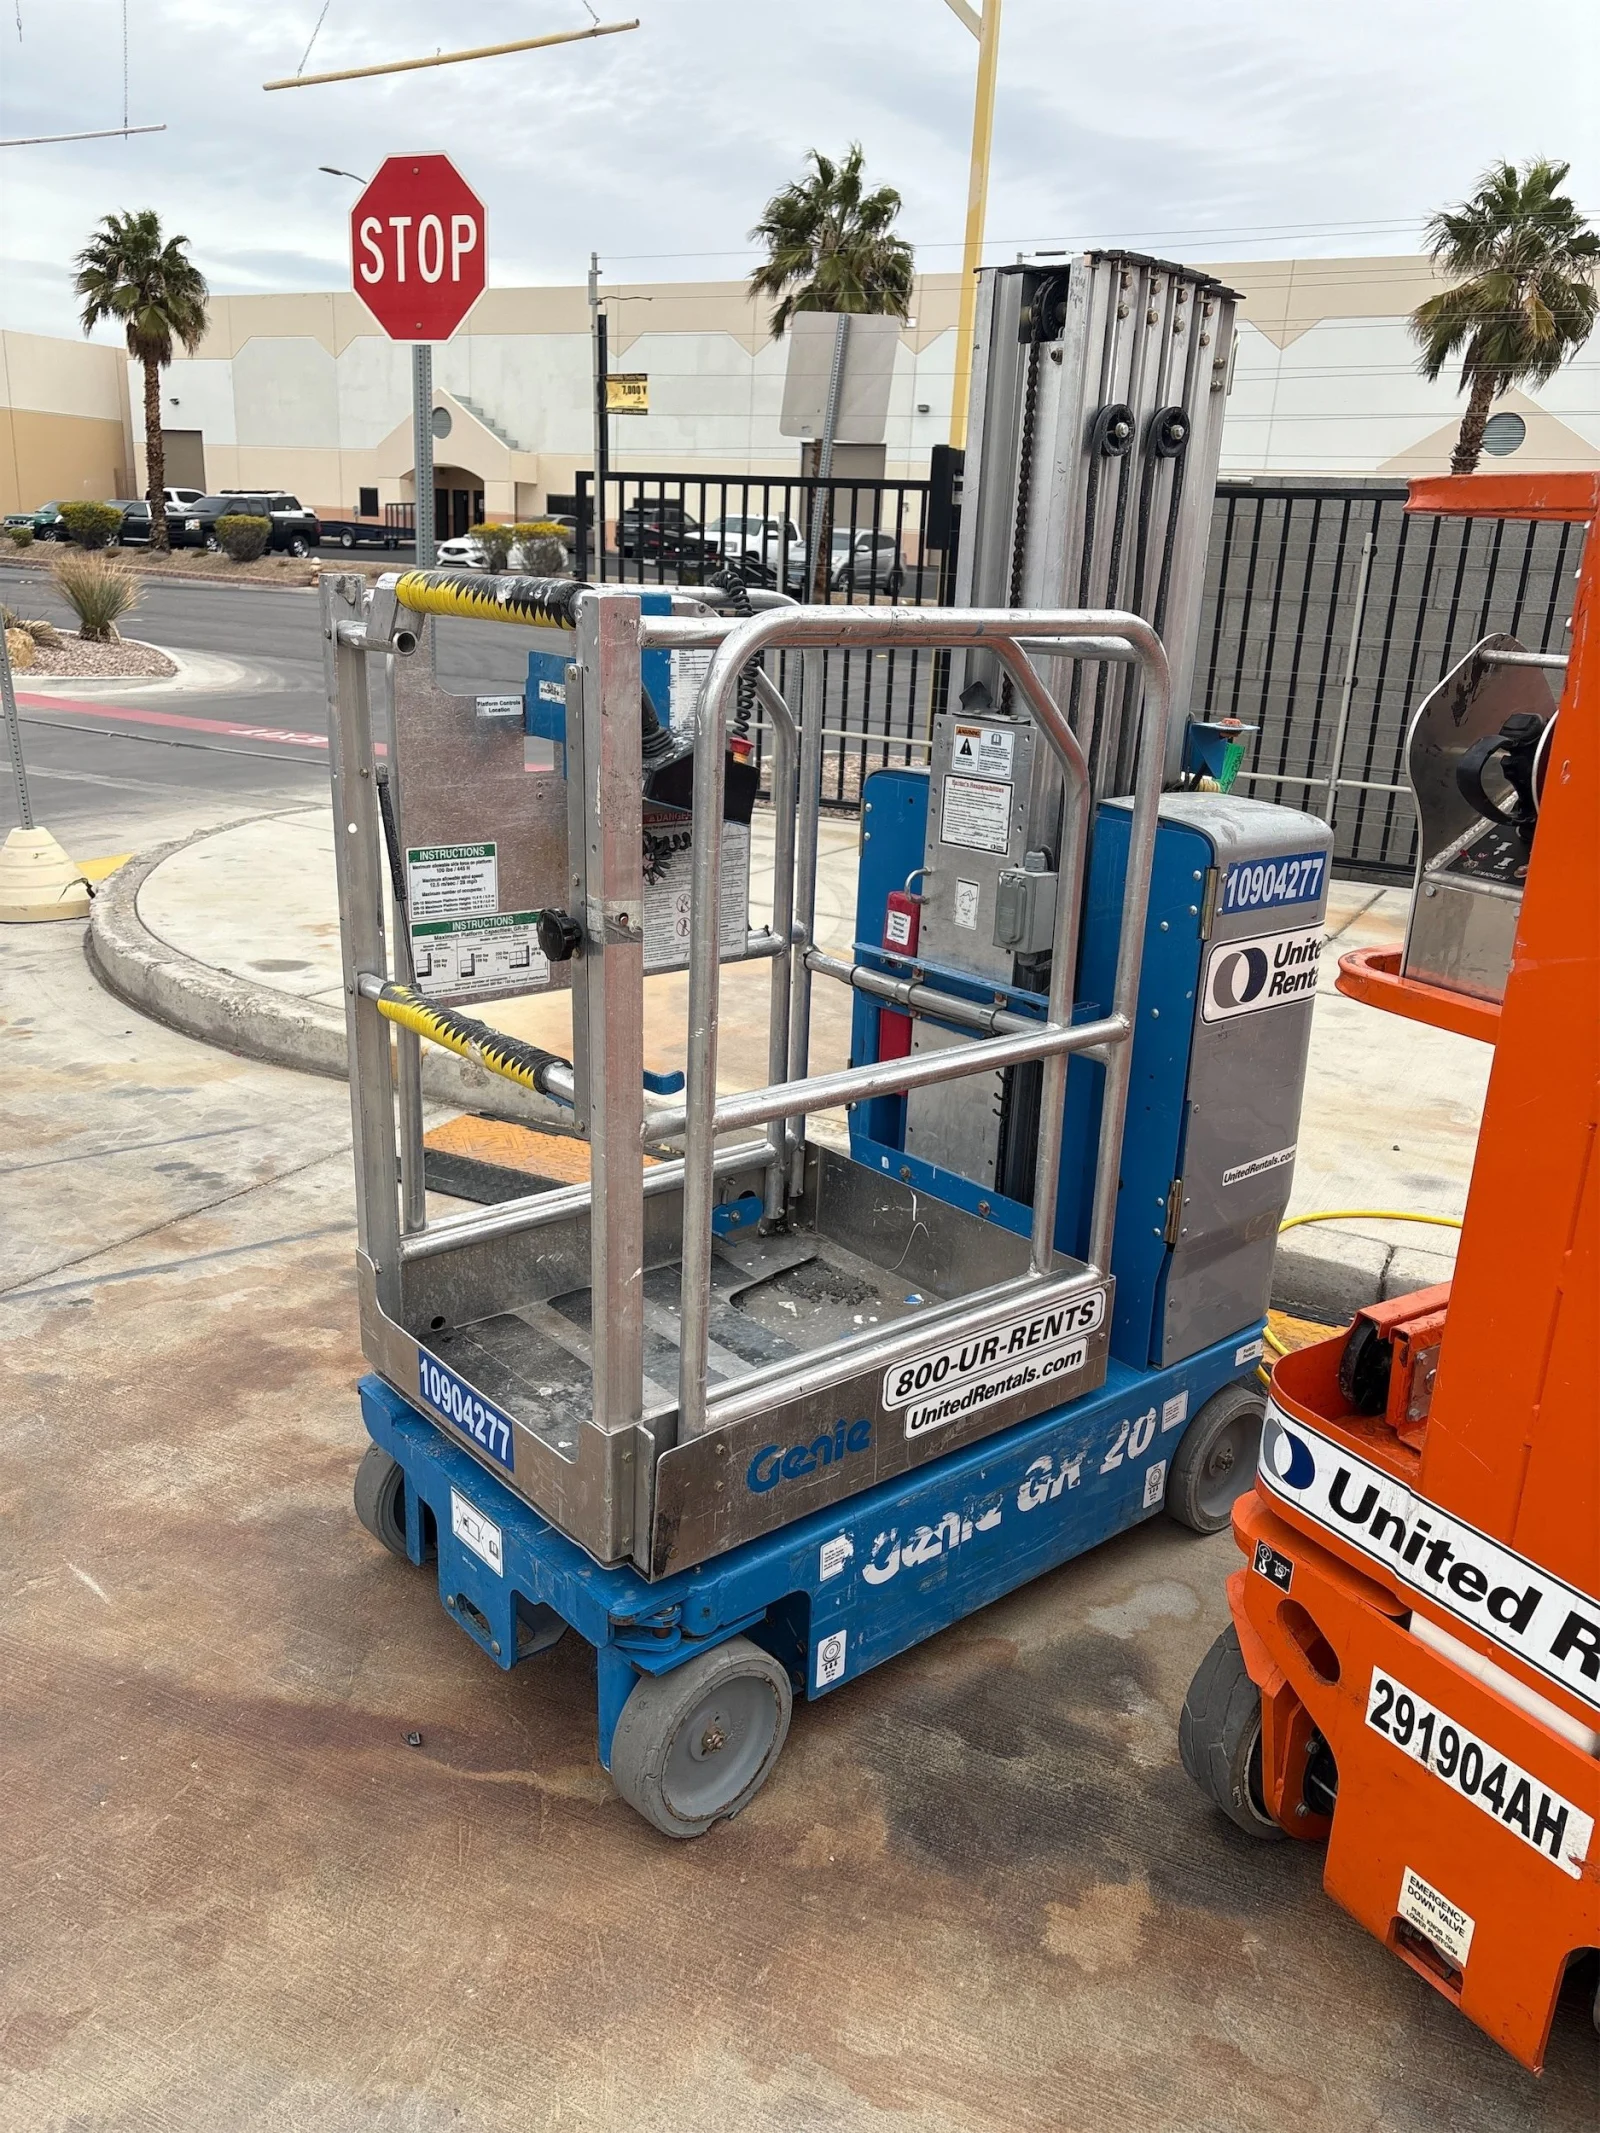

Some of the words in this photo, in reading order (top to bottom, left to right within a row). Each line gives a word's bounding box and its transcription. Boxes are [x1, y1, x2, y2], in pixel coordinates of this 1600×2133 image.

[360, 213, 478, 284] STOP
[621, 385, 641, 395] 7,000
[420, 846, 485, 860] INSTRUCTIONS
[1227, 858, 1324, 908] 10904277
[452, 916, 514, 931] INSTRUCTIONS
[895, 1300, 1095, 1397] 800-UR-RENTS
[420, 1358, 510, 1461] 10904277
[911, 1350, 1082, 1430] UnitedRentals.com
[746, 1417, 872, 1493] Genie
[1099, 1407, 1157, 1475] 20
[1328, 1466, 1543, 1635] United
[1369, 1678, 1569, 1860] 291904AH
[1407, 1885, 1436, 1913] DOWN
[1438, 1909, 1466, 1939] VALVE
[1409, 1875, 1467, 1926] EMERGENCY
[1411, 1906, 1424, 1922] PULL
[1426, 1918, 1443, 1936] KNOB
[1445, 1933, 1453, 1944] TO
[1406, 1909, 1427, 1931] LOWER
[1427, 1928, 1458, 1957] PLATFORM
